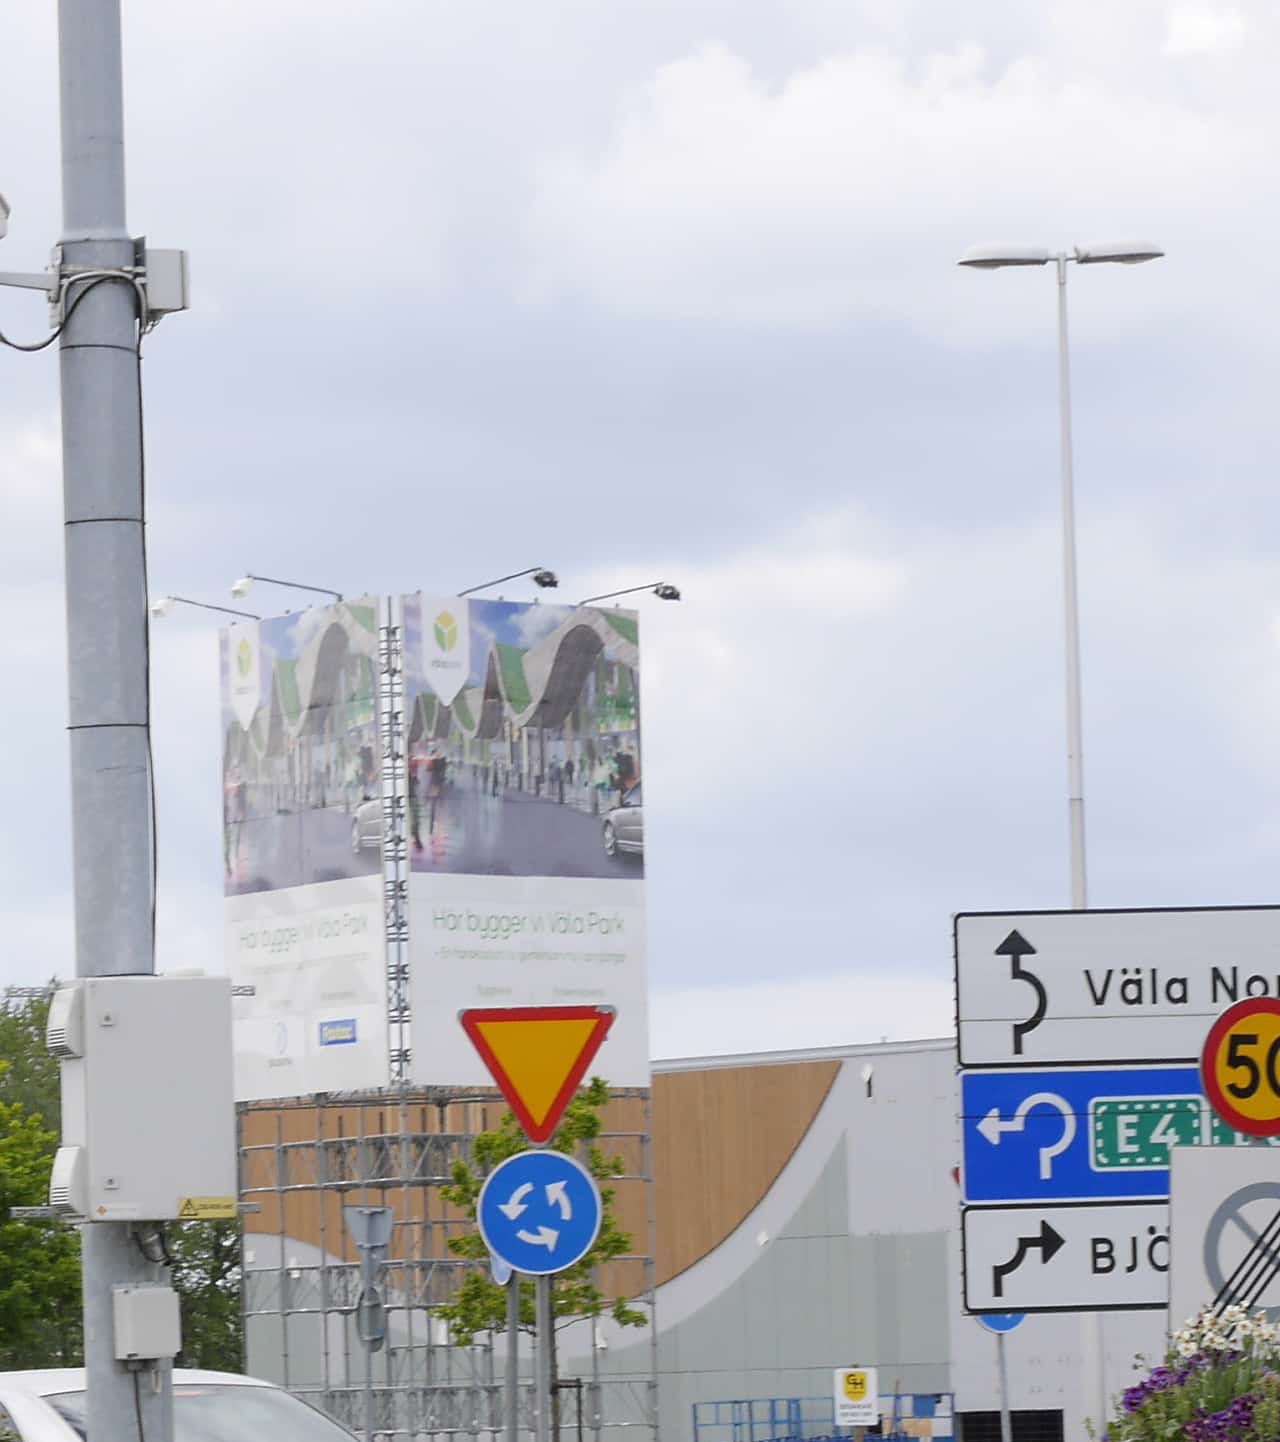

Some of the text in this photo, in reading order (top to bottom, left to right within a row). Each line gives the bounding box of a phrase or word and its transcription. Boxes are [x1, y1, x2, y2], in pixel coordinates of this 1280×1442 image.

[1084, 966, 1280, 1006] Väla No
[1090, 1224, 1169, 1274] BJÖ
